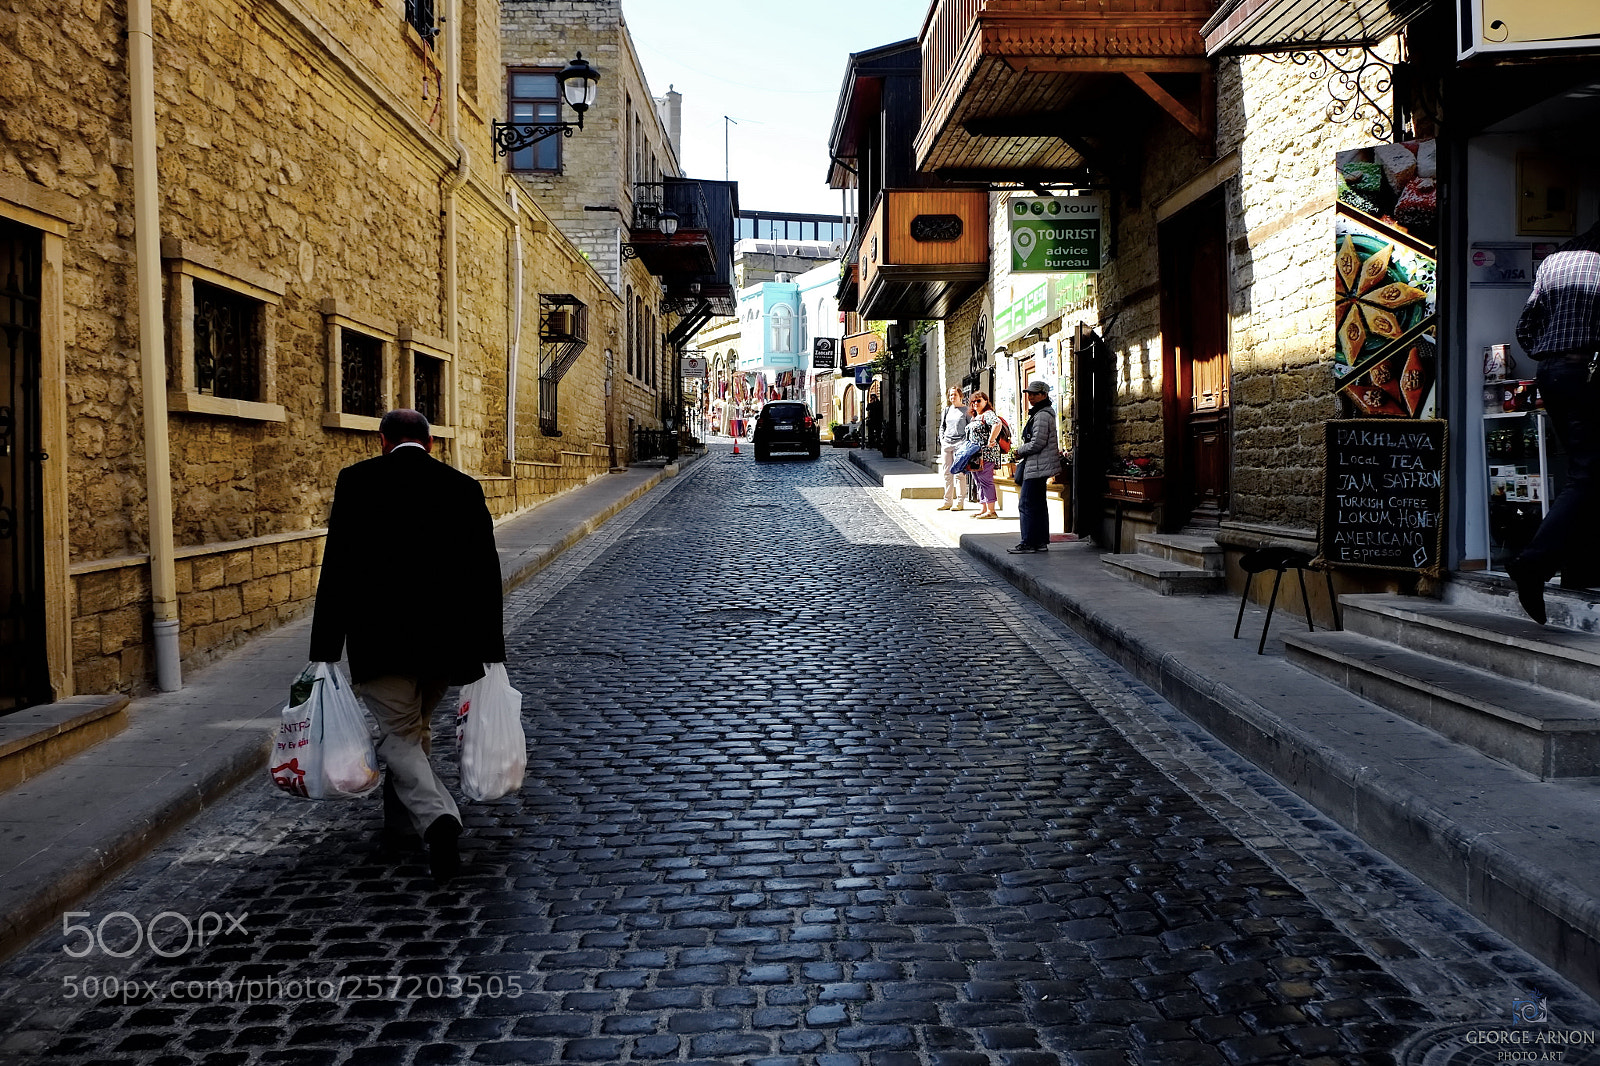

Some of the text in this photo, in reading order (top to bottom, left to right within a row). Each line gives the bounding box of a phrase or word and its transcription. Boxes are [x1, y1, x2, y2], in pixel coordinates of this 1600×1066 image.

[1064, 204, 1098, 214] tour
[1037, 228, 1097, 240] TOURIST
[1046, 246, 1088, 255] advice
[1044, 258, 1090, 267] bureau
[1499, 269, 1526, 279] VISA
[1389, 454, 1427, 470] TEA
[1382, 470, 1441, 488] SAFFRON
[1334, 530, 1424, 547] AMERICANO
[1340, 547, 1402, 562] Espresso
